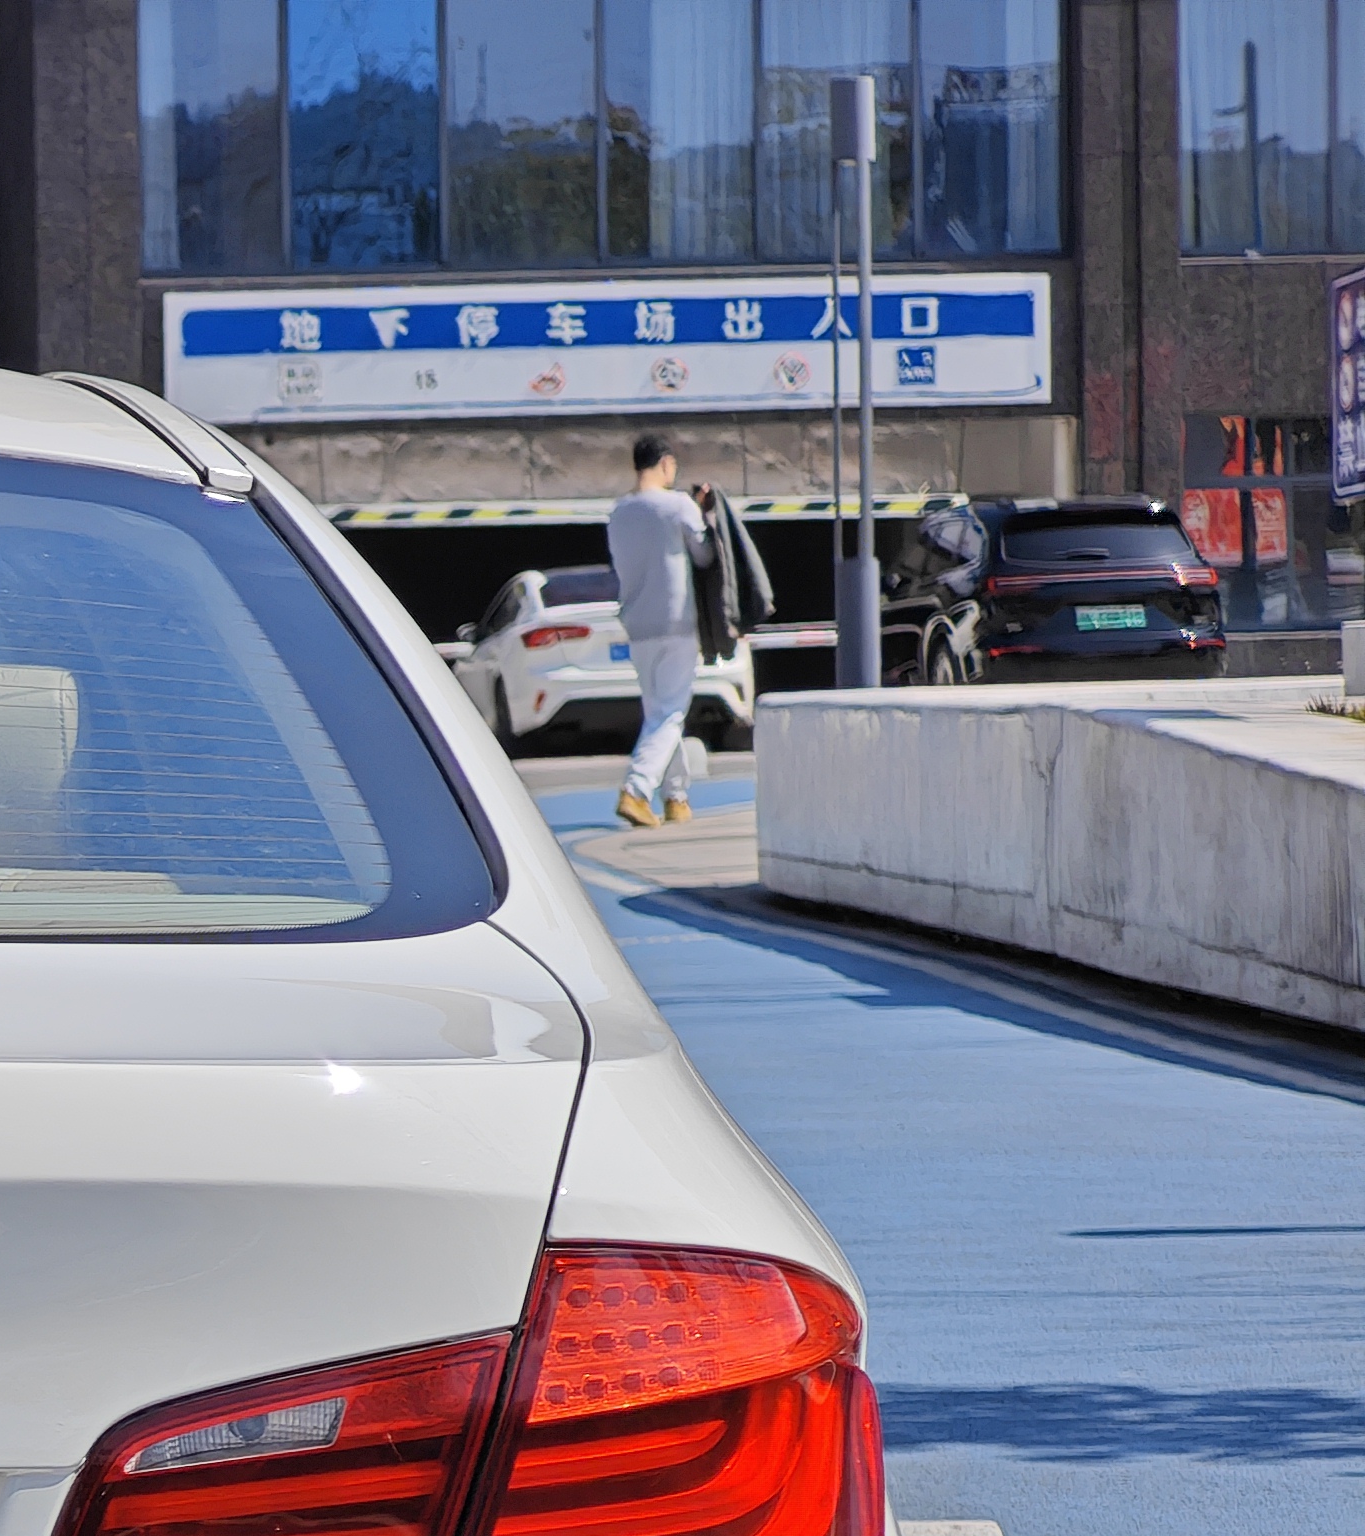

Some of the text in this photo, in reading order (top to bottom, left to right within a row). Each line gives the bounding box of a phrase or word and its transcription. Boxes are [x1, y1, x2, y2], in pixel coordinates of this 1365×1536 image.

[280, 297, 939, 350] 地下停车场出入口
